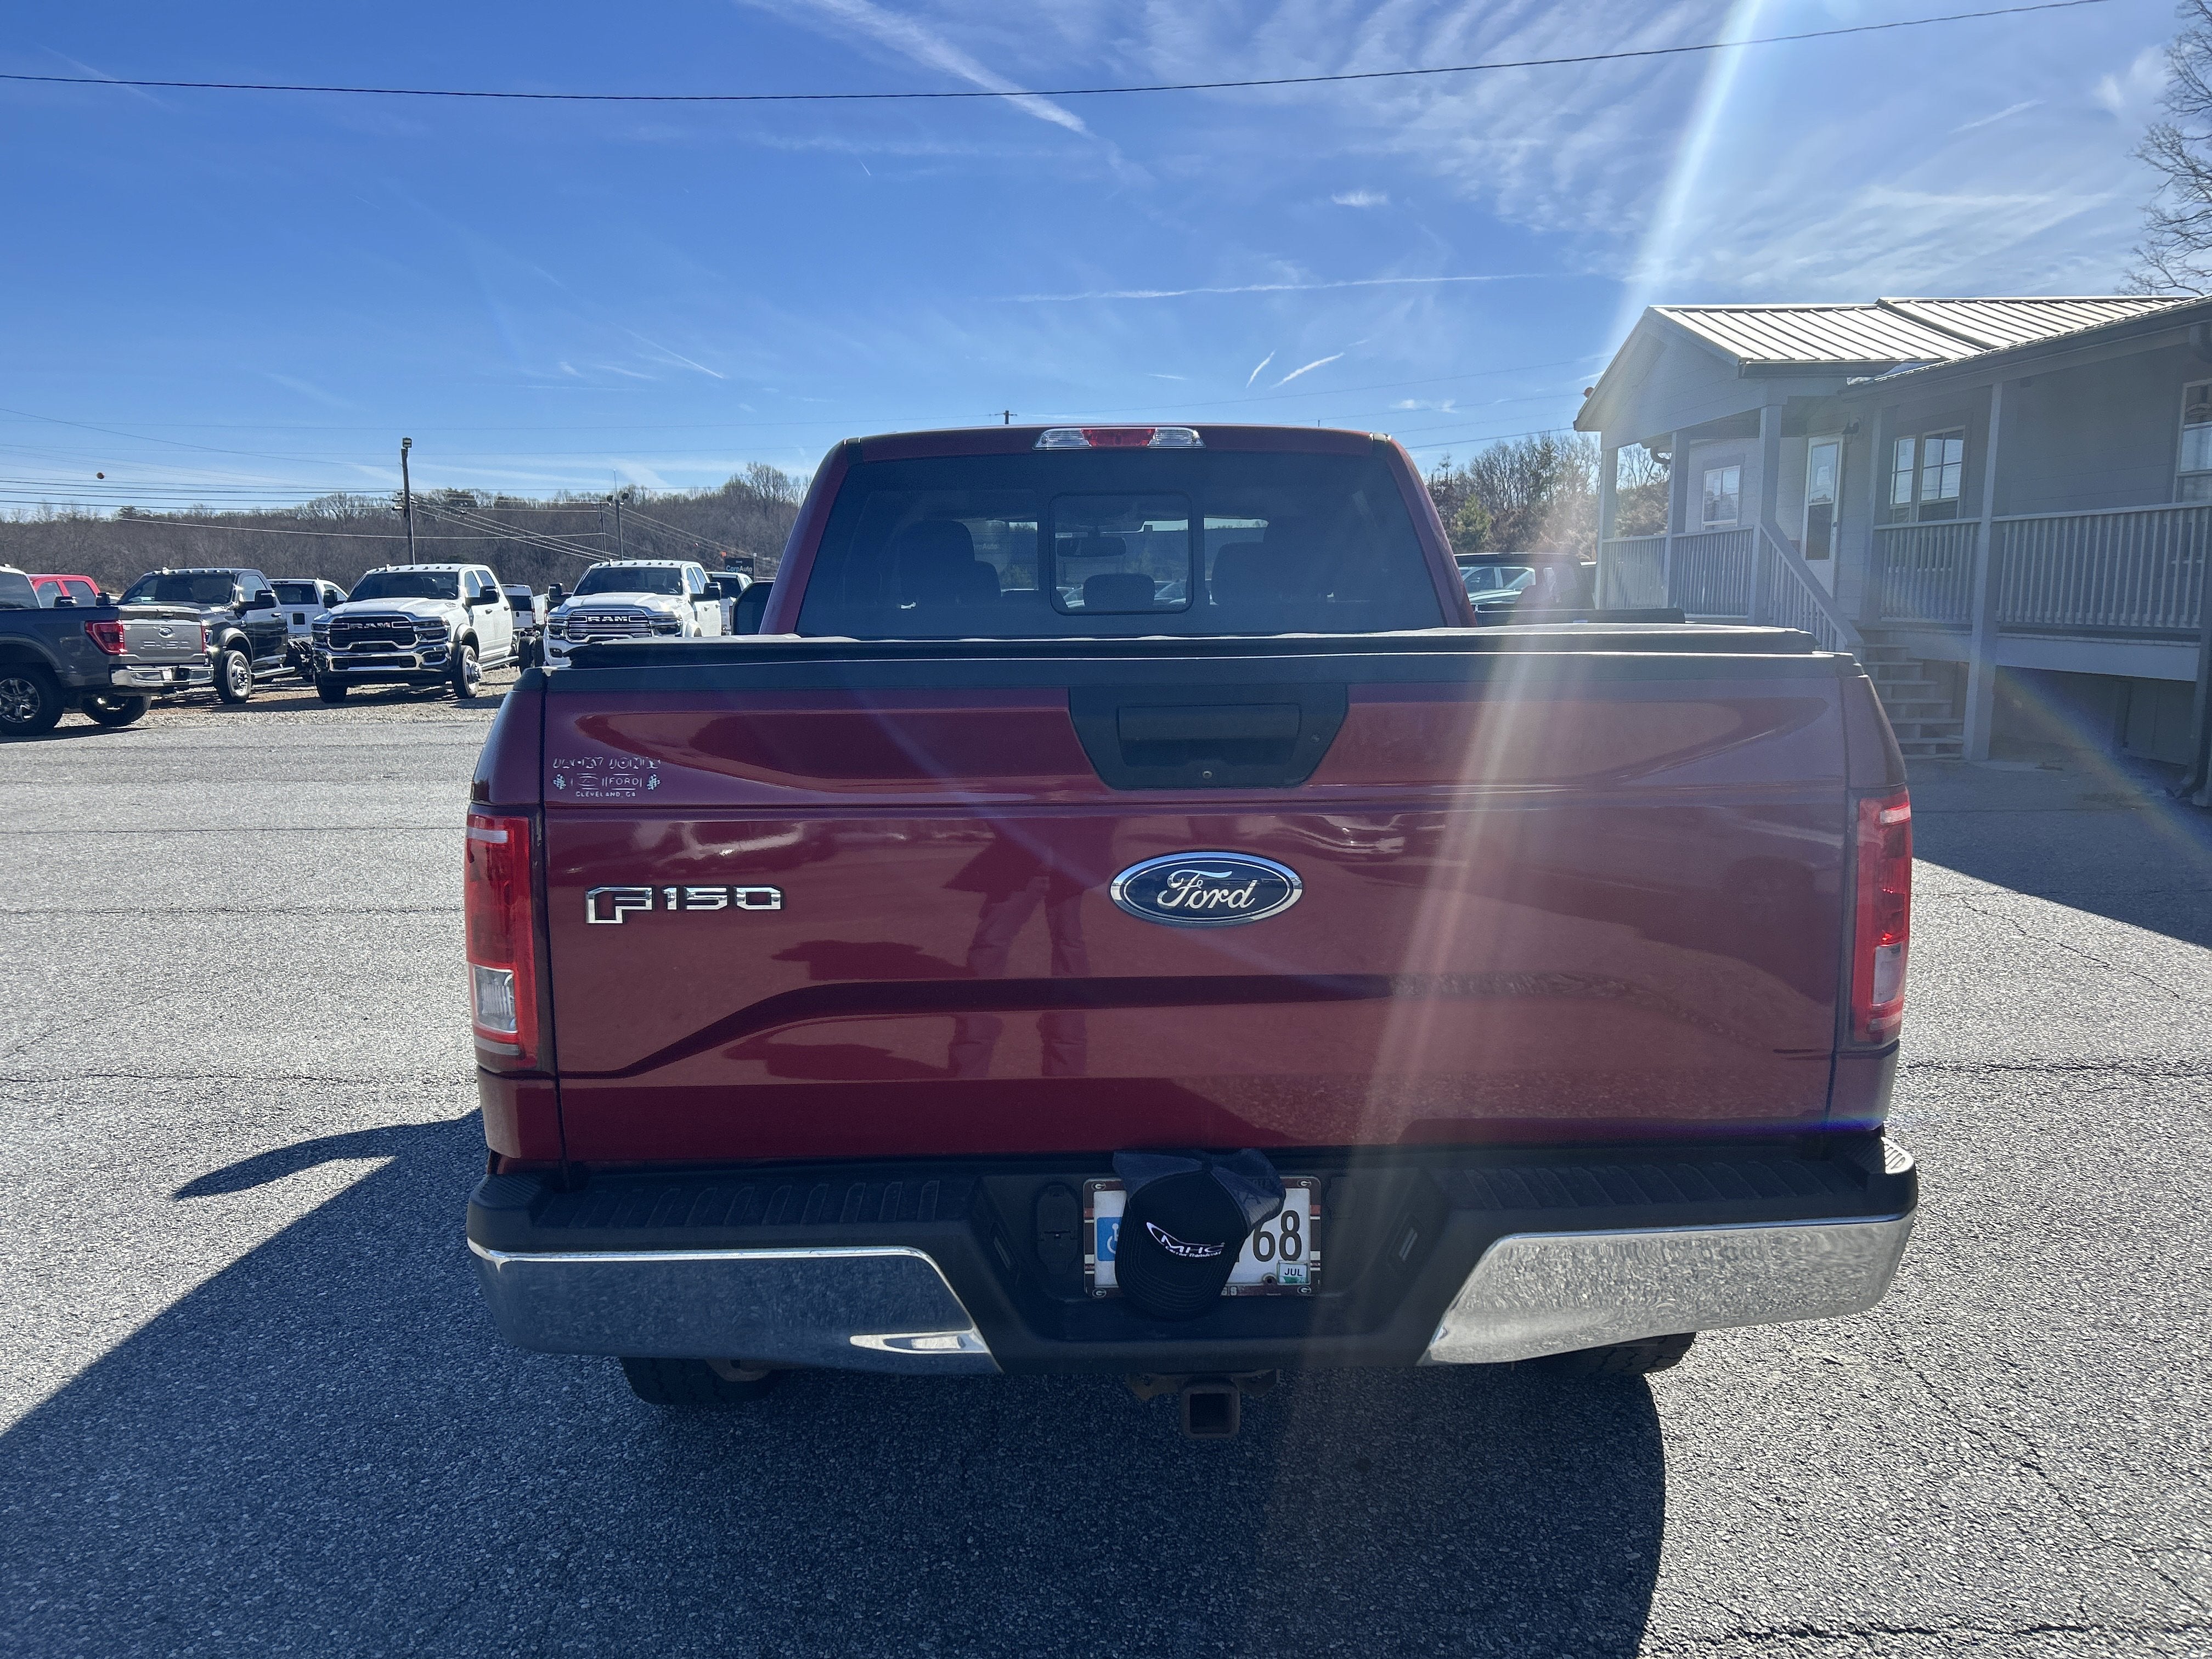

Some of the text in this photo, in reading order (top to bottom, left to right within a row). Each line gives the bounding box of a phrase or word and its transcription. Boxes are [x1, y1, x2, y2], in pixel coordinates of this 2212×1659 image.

[1157, 869, 1256, 909] Ford
[1161, 1234, 1224, 1254] MHC
[1252, 1210, 1303, 1262] 68
[1284, 1268, 1303, 1277] JUL
